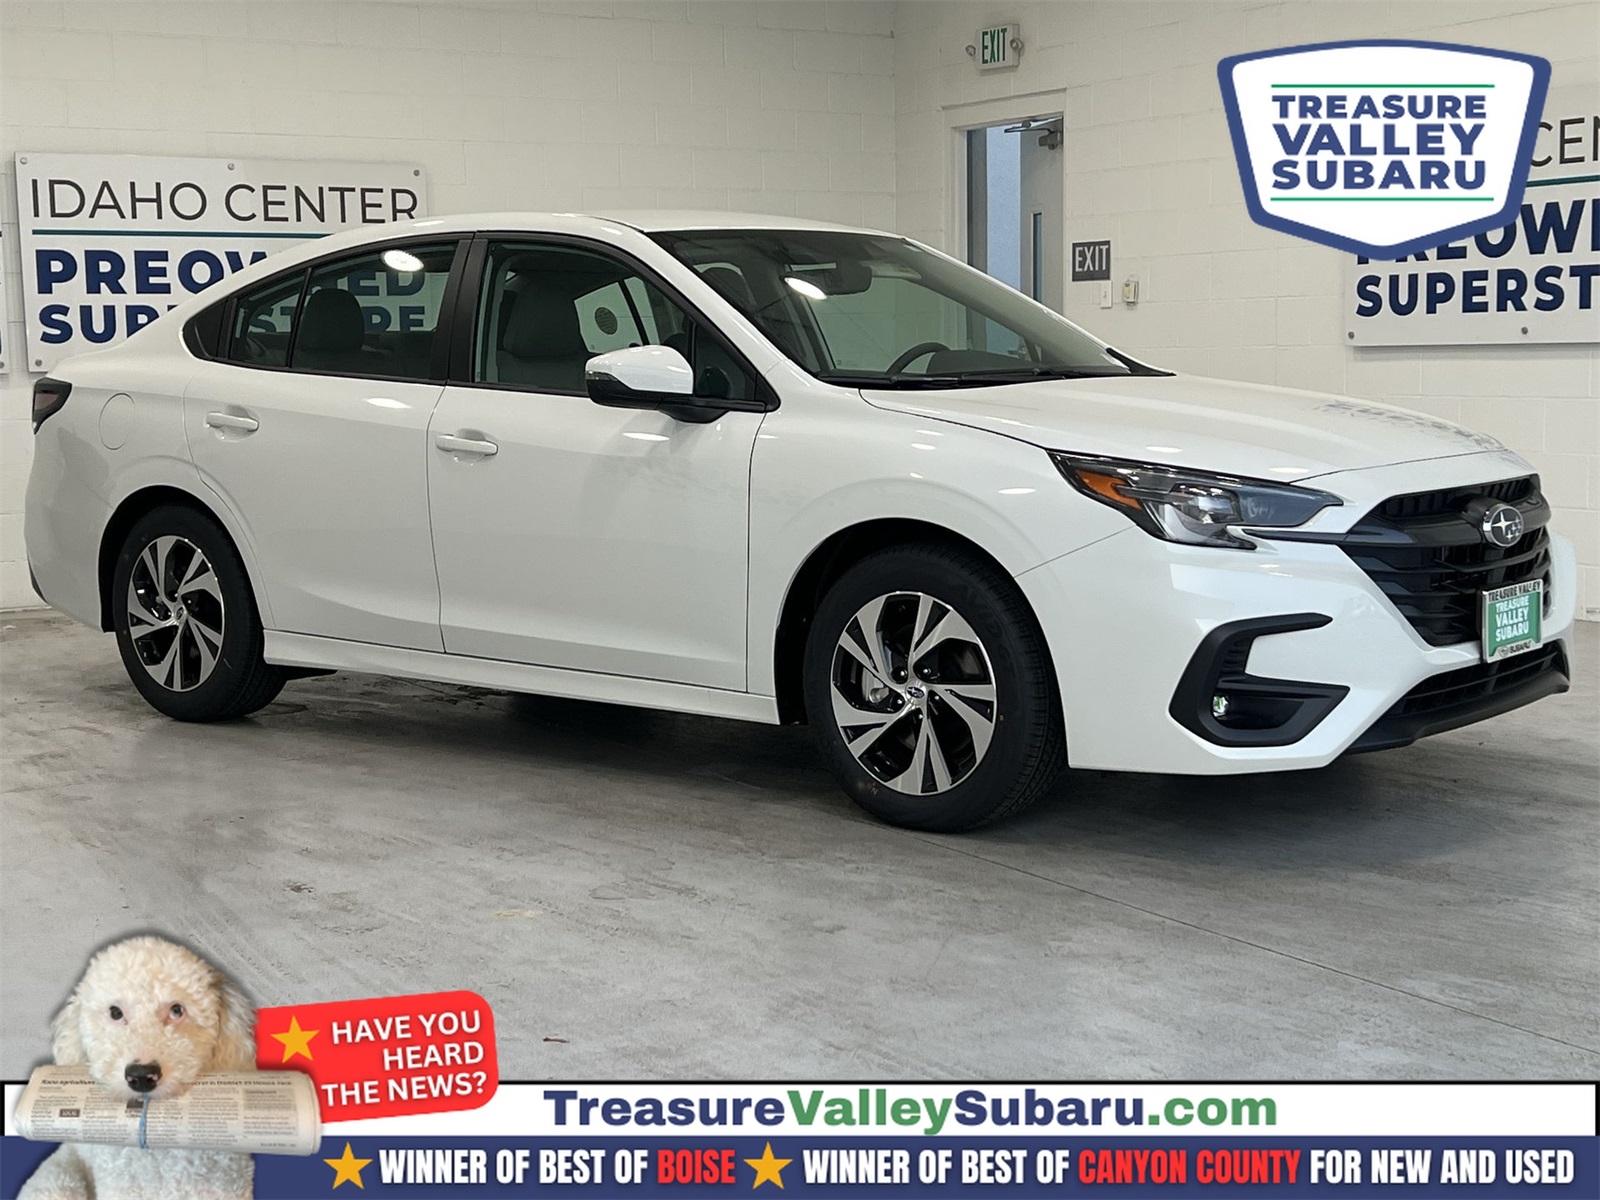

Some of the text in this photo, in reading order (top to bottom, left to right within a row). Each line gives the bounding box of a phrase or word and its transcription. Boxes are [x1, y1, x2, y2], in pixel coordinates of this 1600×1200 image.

[981, 28, 1008, 65] EXIT
[31, 178, 418, 224] IDAHO CENTER
[1074, 245, 1109, 273] EXIT
[1488, 580, 1541, 602] TREASURE VALLEY
[1495, 596, 1529, 613] TREASURE
[1495, 607, 1529, 627] VALLEY
[1496, 621, 1529, 642] SUBARU
